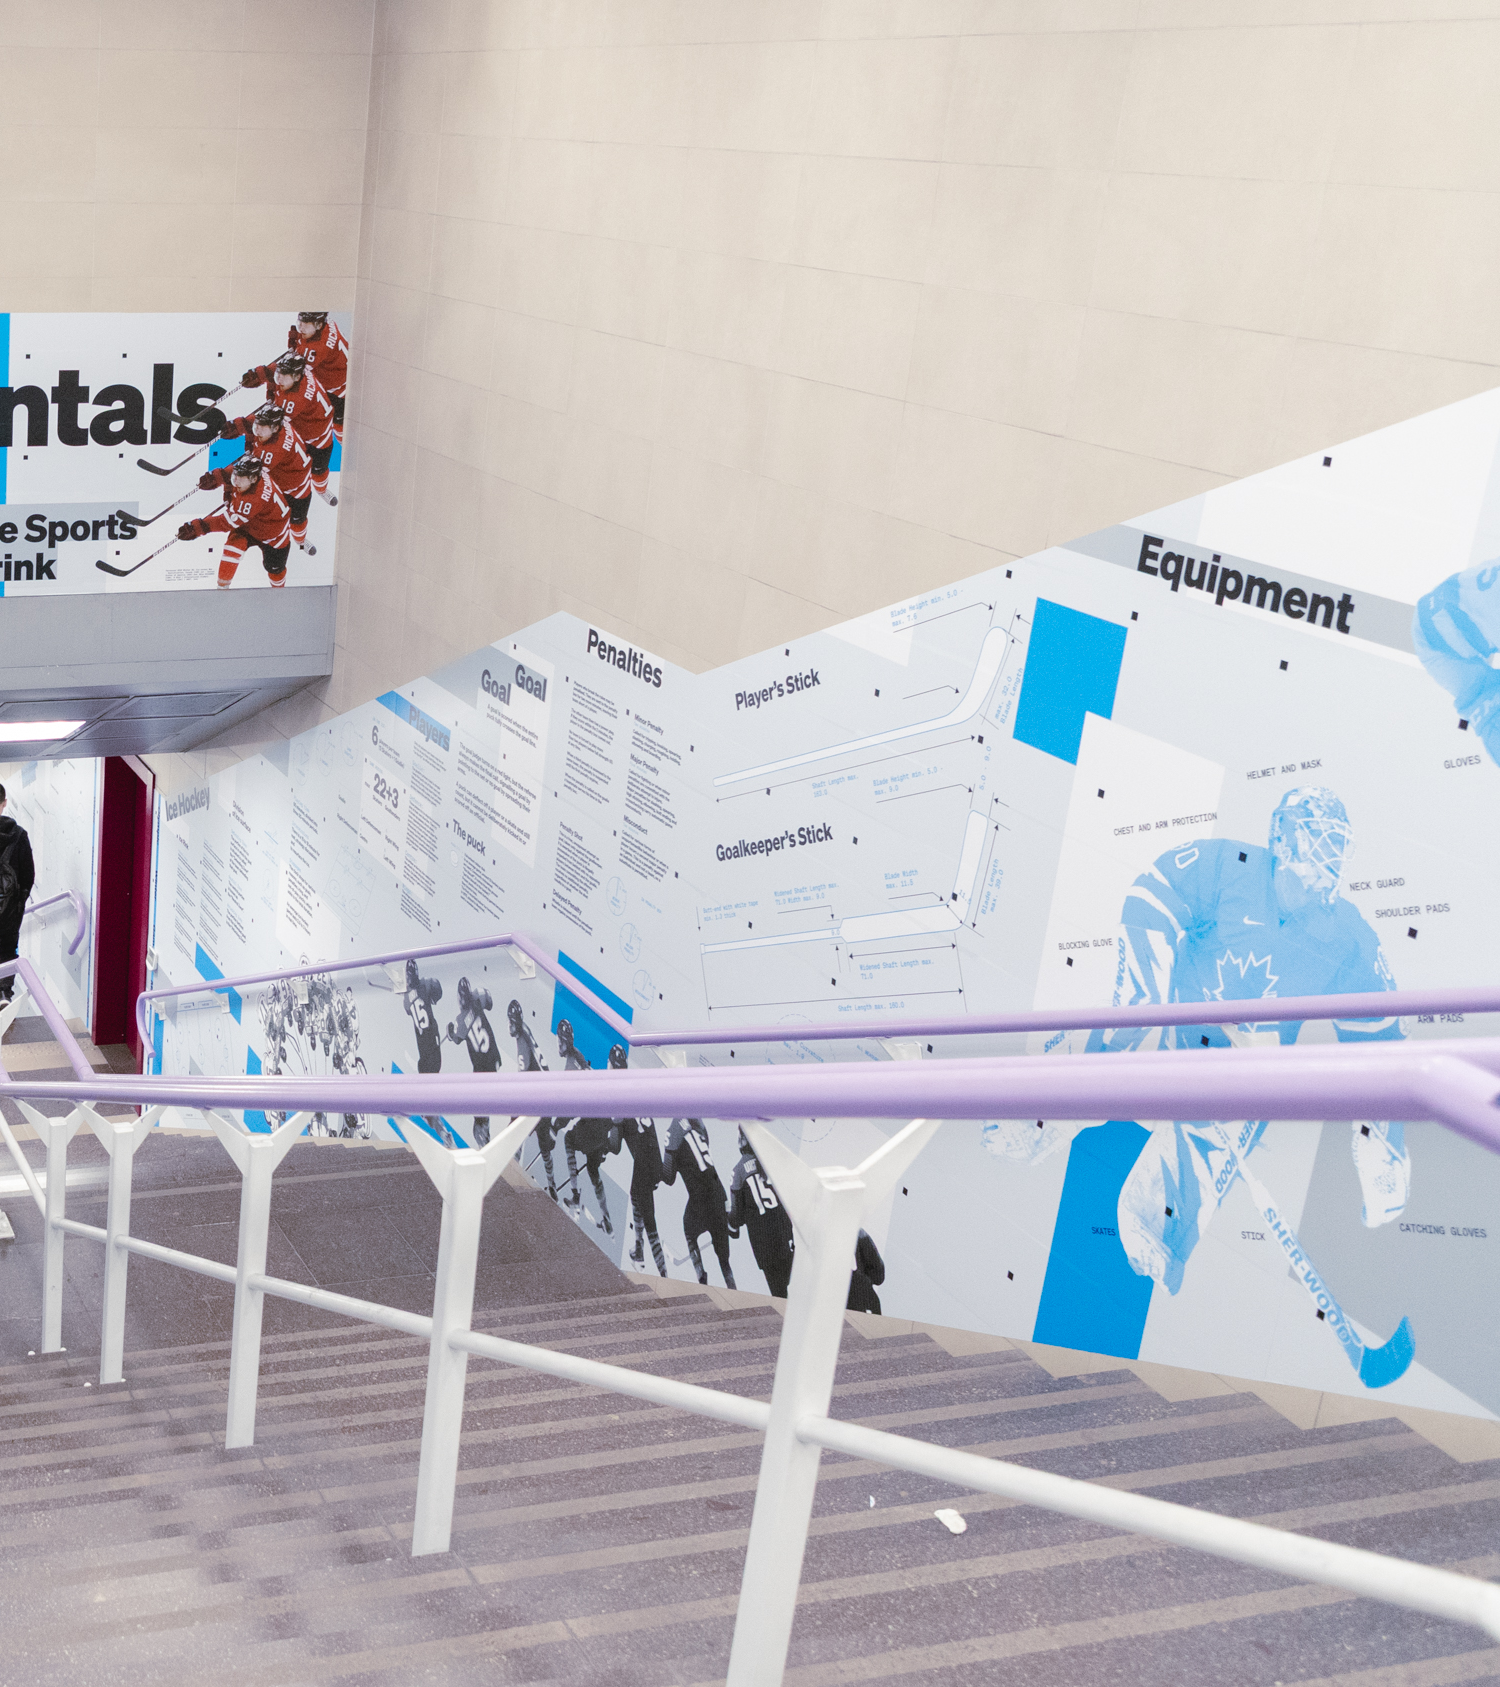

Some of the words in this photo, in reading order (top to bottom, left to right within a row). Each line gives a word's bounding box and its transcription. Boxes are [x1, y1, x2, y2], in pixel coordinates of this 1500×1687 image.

[282, 399, 295, 414] 18
[260, 450, 273, 464] 18
[237, 501, 252, 515] 18
[24, 513, 137, 548] Sports
[0, 553, 56, 581] rink
[1137, 534, 1355, 634] Equipment
[587, 628, 662, 688] Penalties
[481, 669, 511, 706] Goal
[515, 664, 547, 703] Goal
[786, 668, 821, 695] Stick
[372, 725, 378, 746] 6
[409, 704, 450, 752] Players
[1246, 767, 1276, 781] HELMET
[1281, 763, 1297, 775] AND
[1301, 758, 1322, 771] MASK
[1443, 755, 1482, 770] GLOVES
[373, 773, 399, 808] 22+3
[165, 800, 178, 822] Ice
[178, 787, 210, 816] Hockey
[453, 818, 466, 840] The
[467, 833, 486, 856] puck
[798, 822, 833, 846] Stick
[1113, 824, 1135, 837] CHEST
[1138, 822, 1152, 833] AND
[1155, 819, 1168, 830] ARM
[1172, 812, 1218, 827] PROTECTION
[1349, 880, 1372, 892] NECK
[1377, 877, 1406, 890] GUARD
[1375, 906, 1421, 918] SHOULDER
[1426, 903, 1451, 915] PADS
[1058, 940, 1090, 951] BLOCKING
[1093, 938, 1114, 948] GLOVE
[409, 998, 430, 1036] 15
[1441, 1013, 1465, 1024] PADS
[467, 1016, 490, 1054] 15
[745, 1173, 779, 1216] 15
[1091, 1226, 1117, 1237] SKATES
[1241, 1231, 1266, 1241] STICK
[1400, 1222, 1446, 1236] CATCHING
[1451, 1226, 1487, 1239] GLOVES
[1264, 1207, 1351, 1344] SHER-WOOD
